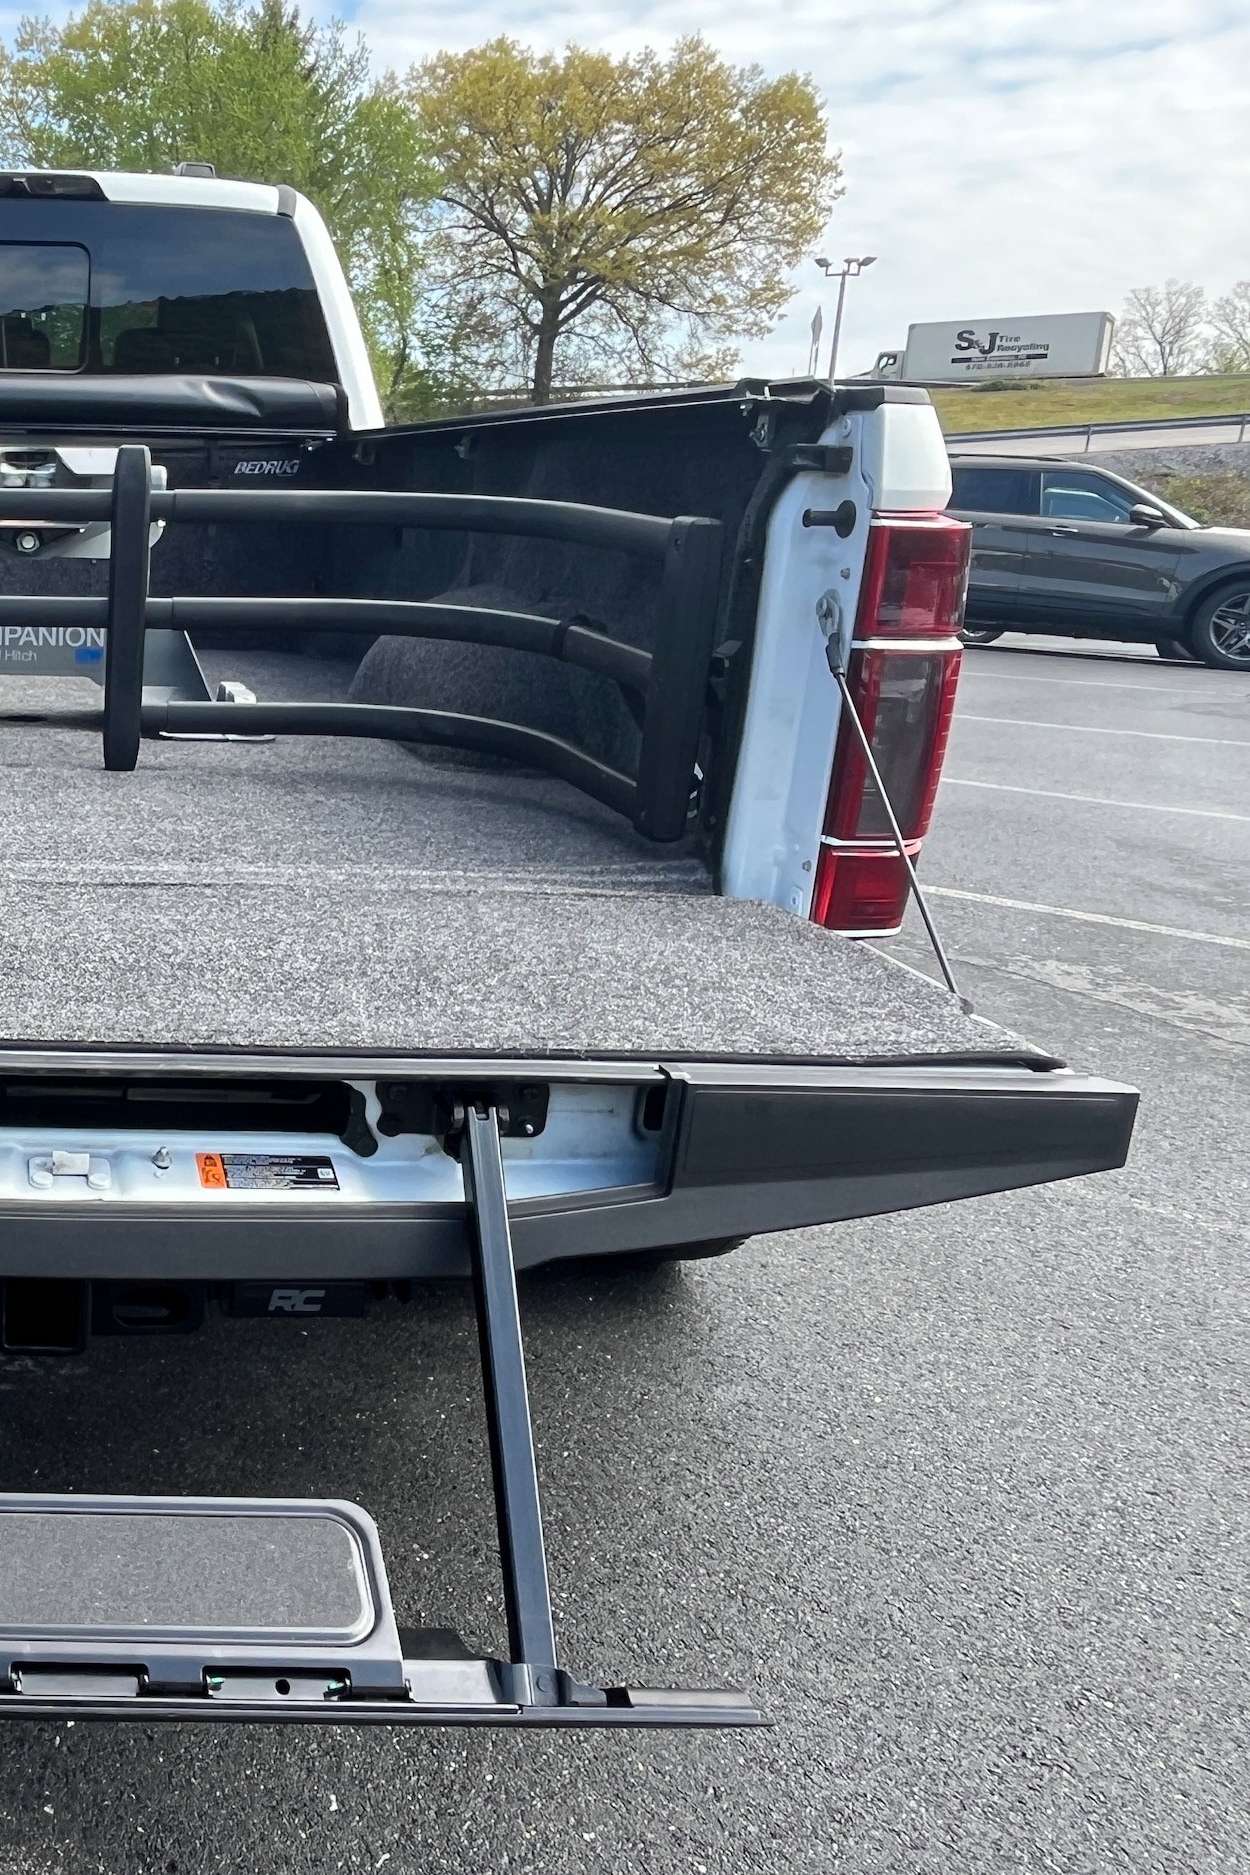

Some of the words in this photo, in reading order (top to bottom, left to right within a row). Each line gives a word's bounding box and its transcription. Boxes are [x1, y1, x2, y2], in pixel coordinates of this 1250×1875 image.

[955, 330, 999, 354] S&J
[999, 335, 1021, 343] Tire
[997, 343, 1049, 352] Recycling
[234, 460, 299, 474] BEDRUG
[4, 649, 38, 662] Hitch
